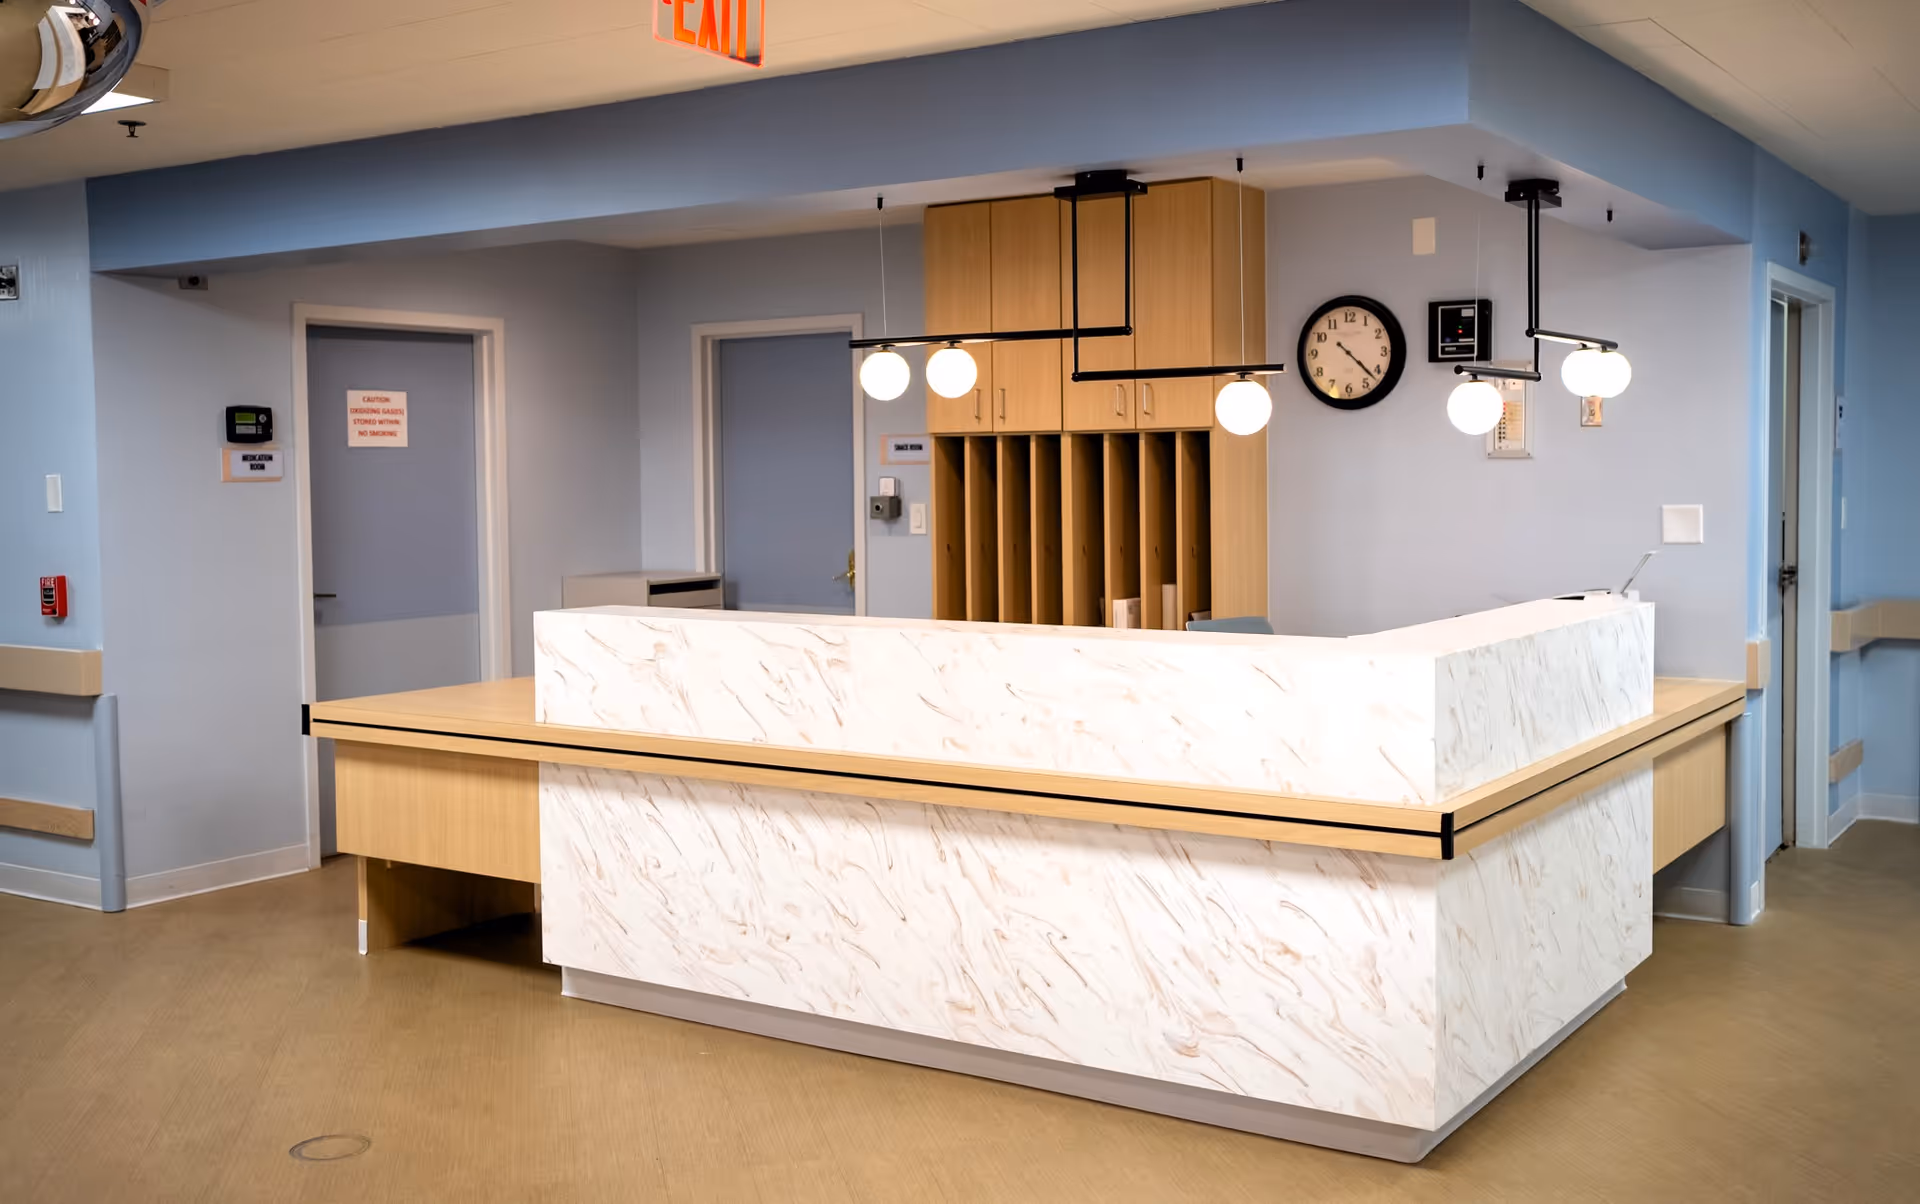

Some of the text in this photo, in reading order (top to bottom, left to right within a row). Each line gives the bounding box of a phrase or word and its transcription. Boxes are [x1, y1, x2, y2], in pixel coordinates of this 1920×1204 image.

[1344, 312, 1356, 323] 12
[1363, 316, 1368, 326] 1
[1328, 319, 1337, 330] 11
[1317, 332, 1327, 343] 10
[1375, 328, 1382, 339] 2
[1311, 349, 1318, 359] 9
[1380, 346, 1388, 357] 3
[1316, 367, 1323, 377] 8
[1374, 364, 1381, 375] 4
[1329, 379, 1335, 389] 7
[1345, 383, 1352, 394] 6
[1362, 378, 1369, 389] 5
[242, 454, 273, 462] MEDICATION
[41, 578, 55, 586] FIRE
